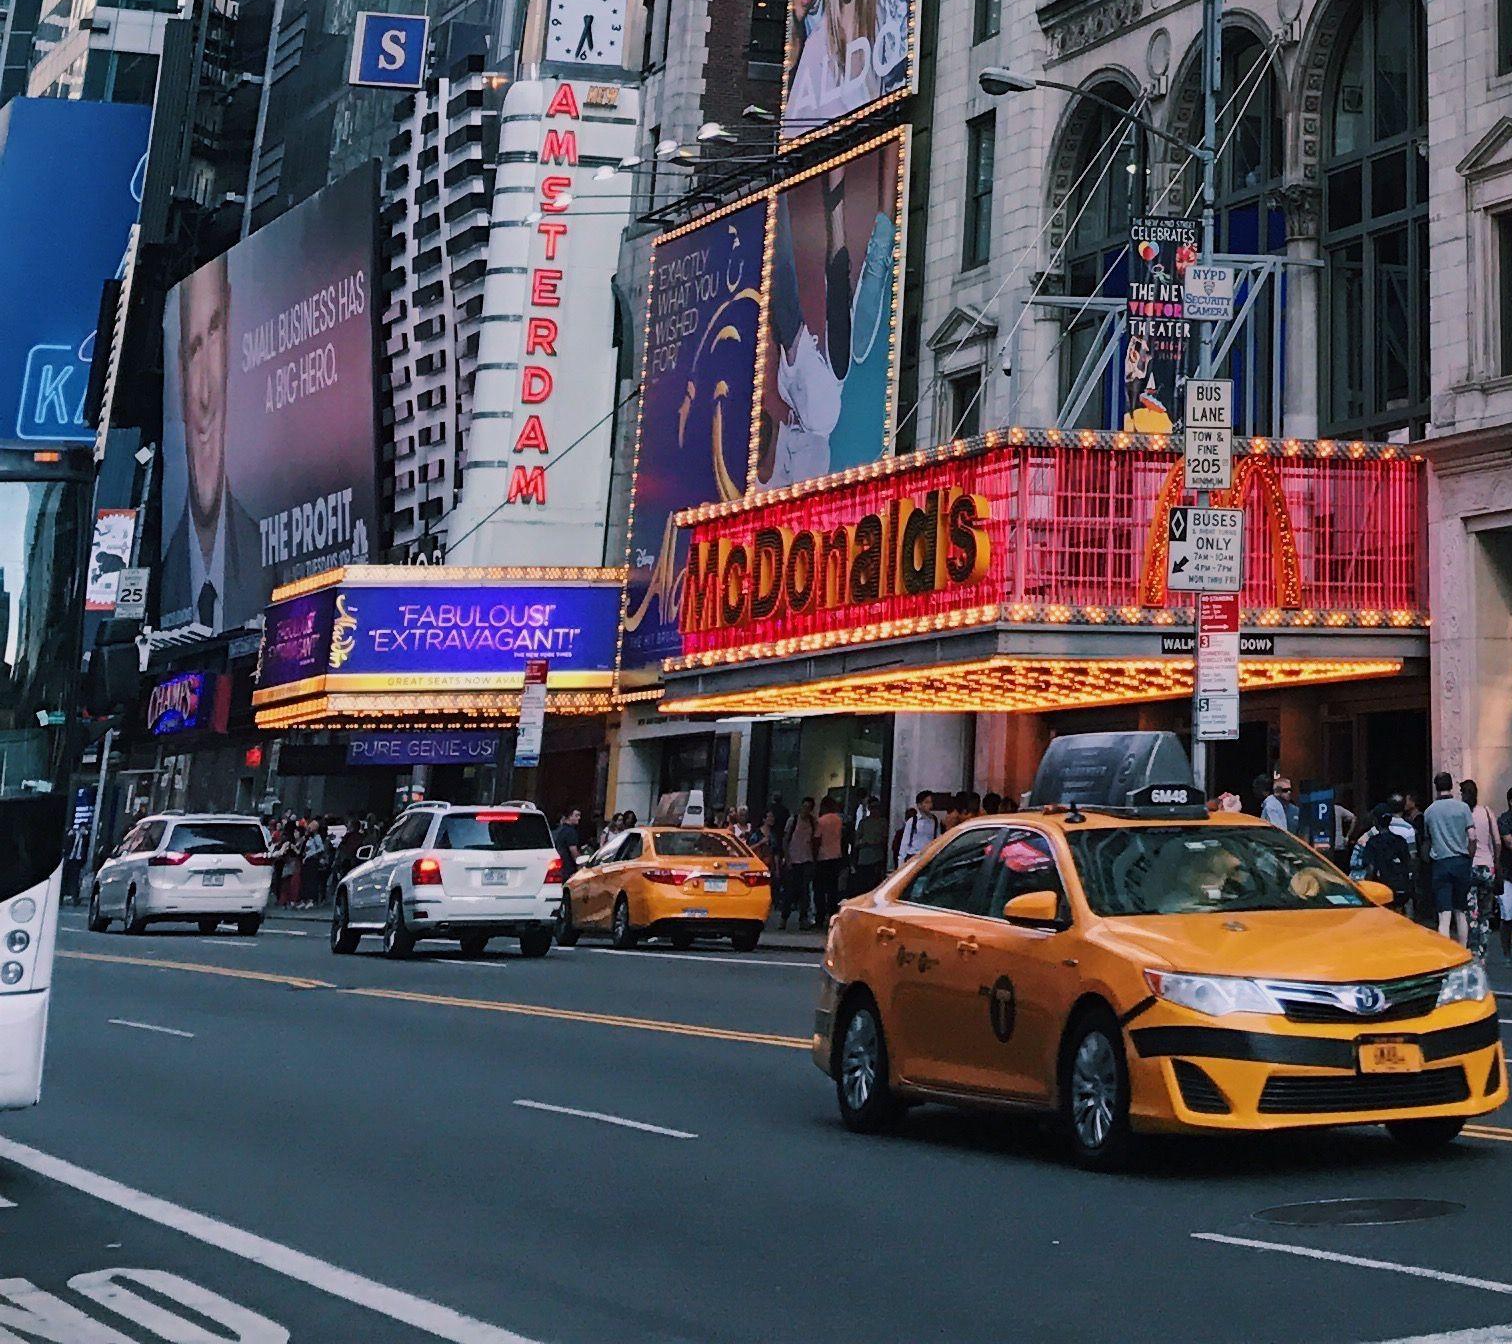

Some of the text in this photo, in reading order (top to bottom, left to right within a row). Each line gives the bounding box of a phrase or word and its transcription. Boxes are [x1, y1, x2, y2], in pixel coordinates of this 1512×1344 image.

[1131, 225, 1195, 244] CELEBRATES
[1192, 268, 1227, 281] NYPD
[507, 82, 581, 506] AMSTERDAM
[657, 271, 720, 316] WHAT YOU
[1129, 282, 1185, 302] THE NE
[1184, 293, 1232, 306] SECURITY
[1128, 301, 1183, 318] VICTOR
[1186, 304, 1229, 317] CAMERA
[241, 269, 366, 374] SMALL BUSINESS HAS
[654, 307, 700, 346] WISHED
[1128, 320, 1191, 338] THEATER
[265, 342, 338, 413] A BIG HERO.
[1196, 385, 1222, 402] BUS
[1192, 407, 1225, 423] LANE
[1192, 431, 1225, 442] TOW &
[1197, 444, 1219, 456] FINE
[1192, 477, 1224, 486] MINIMUM
[259, 487, 353, 568] THE PROFIT
[1192, 512, 1237, 528] BUSES
[1196, 536, 1232, 551] ONLY
[681, 486, 991, 633] McDonald's
[119, 588, 144, 603] 25
[1201, 635, 1209, 648] 3
[387, 676, 424, 687] GREAT
[427, 675, 461, 686] SEATS
[464, 675, 492, 686] NOW
[1200, 699, 1208, 712] 5
[1150, 788, 1188, 804] 6M48
[1318, 803, 1328, 820] P
